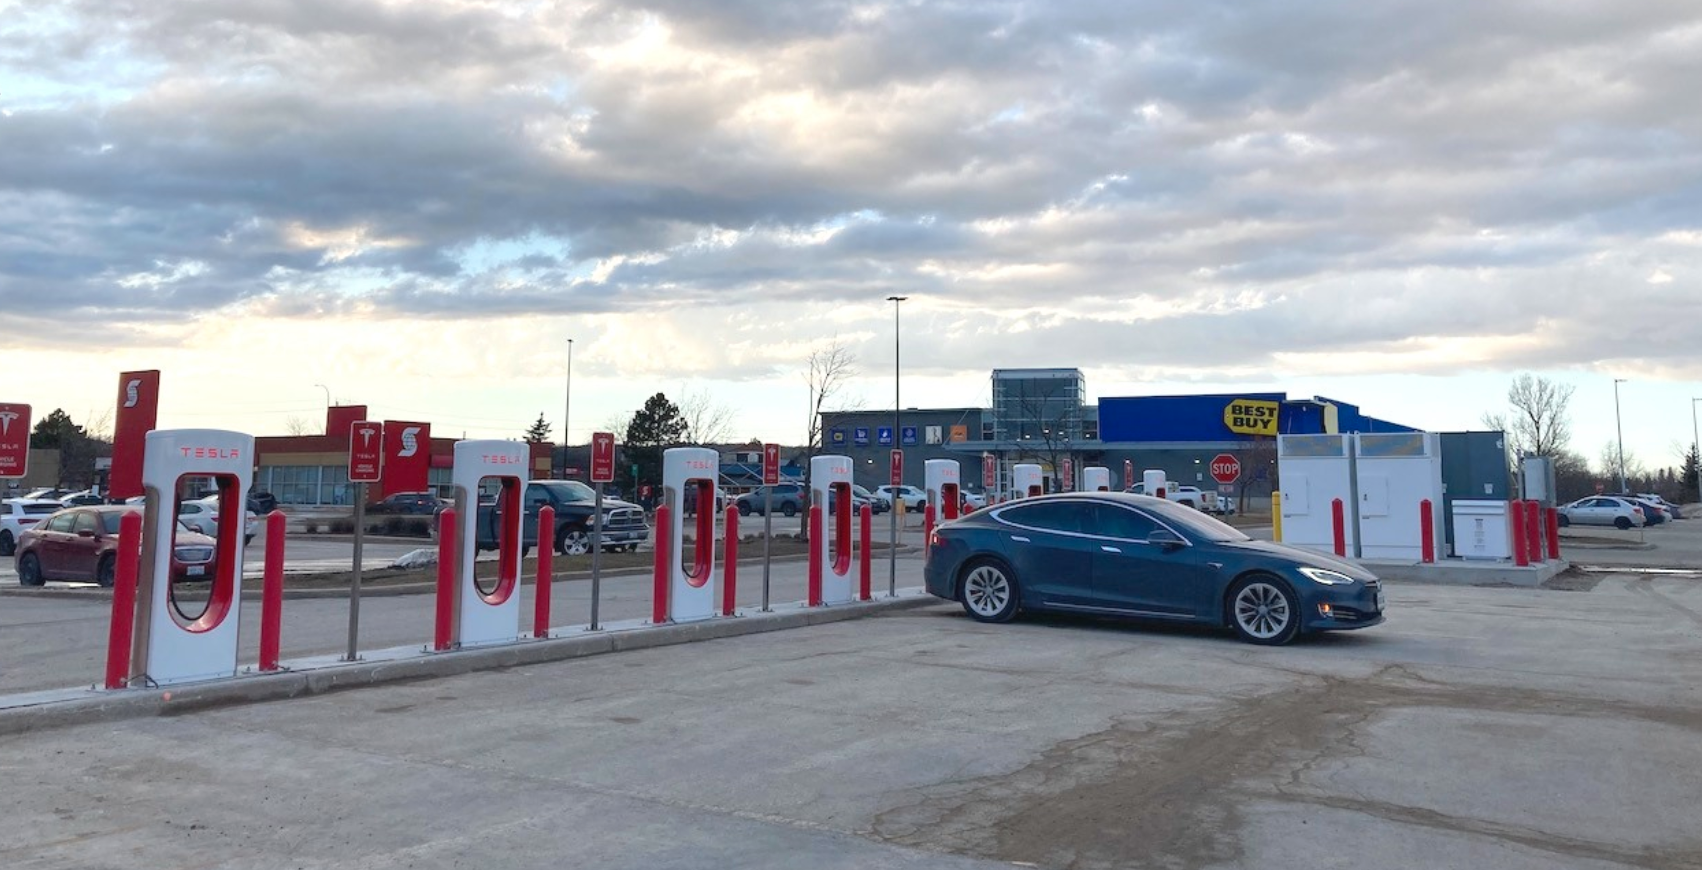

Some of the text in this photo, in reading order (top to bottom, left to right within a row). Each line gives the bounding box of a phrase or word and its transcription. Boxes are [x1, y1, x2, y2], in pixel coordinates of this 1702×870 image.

[1231, 404, 1277, 418] BEST
[1232, 417, 1273, 429] BUY
[180, 447, 239, 459] TESLA
[481, 454, 521, 464] TESLA
[685, 461, 714, 469] TESLA
[1212, 463, 1239, 475] STOP
